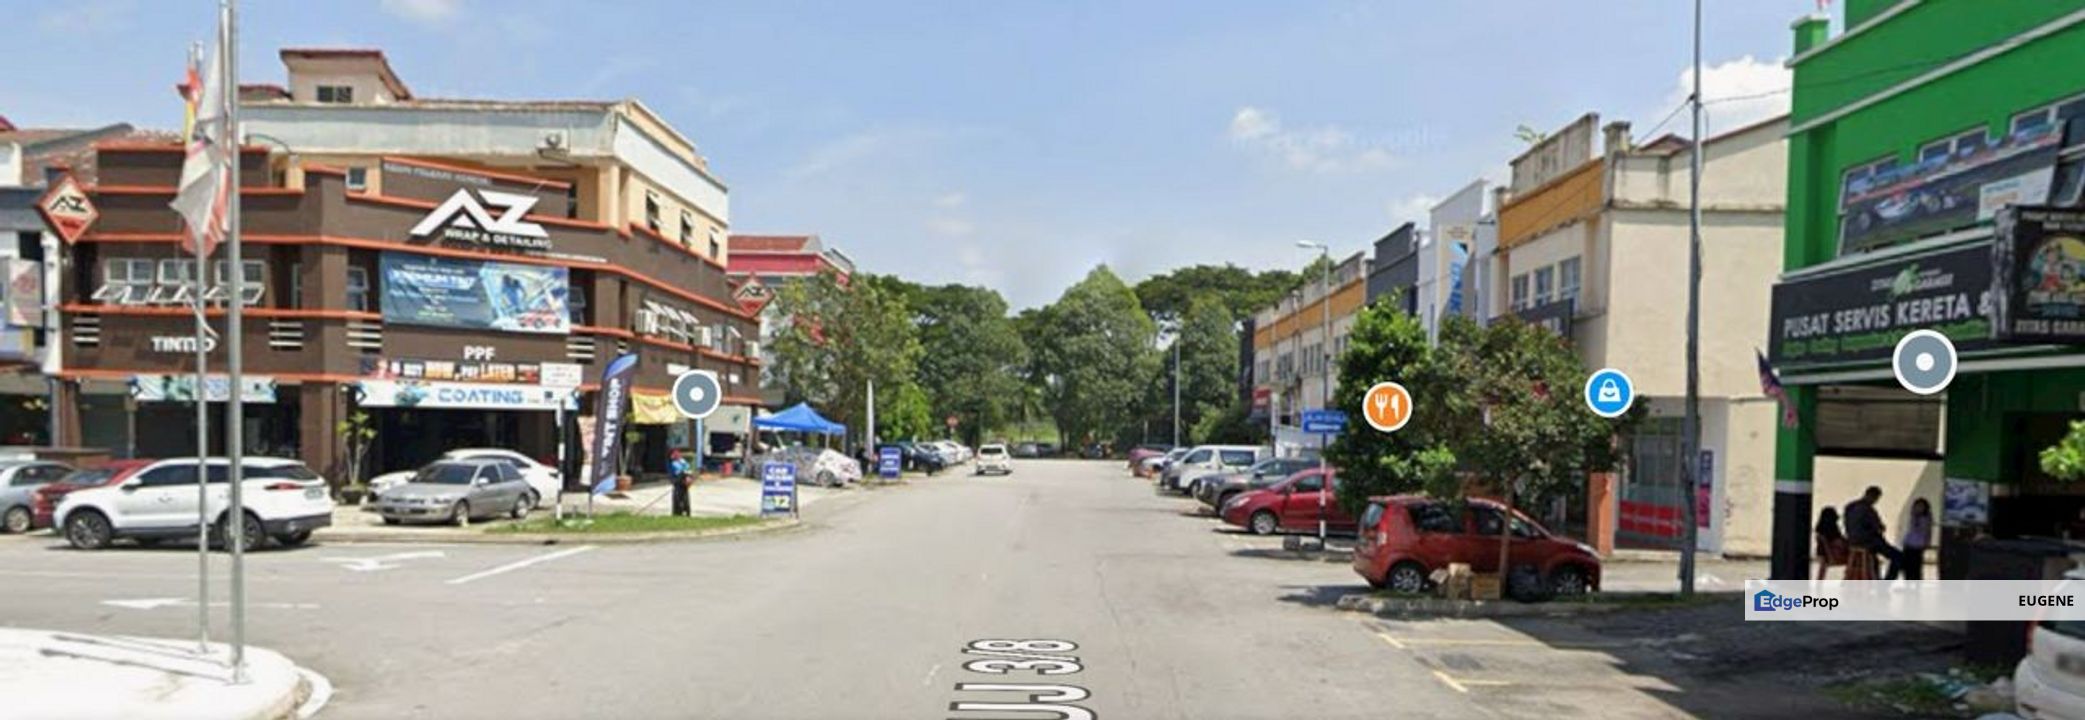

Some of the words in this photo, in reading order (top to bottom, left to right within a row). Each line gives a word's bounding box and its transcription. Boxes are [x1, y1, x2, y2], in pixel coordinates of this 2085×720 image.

[410, 187, 549, 237] AZ
[445, 228, 480, 242] WRAP
[493, 235, 553, 250] DETAILING
[1783, 311, 1829, 339] PUSAT
[1832, 304, 1890, 333] SERVIS
[1895, 293, 1971, 325] KERETA
[463, 345, 496, 362] PPF
[437, 387, 524, 405] COATING
